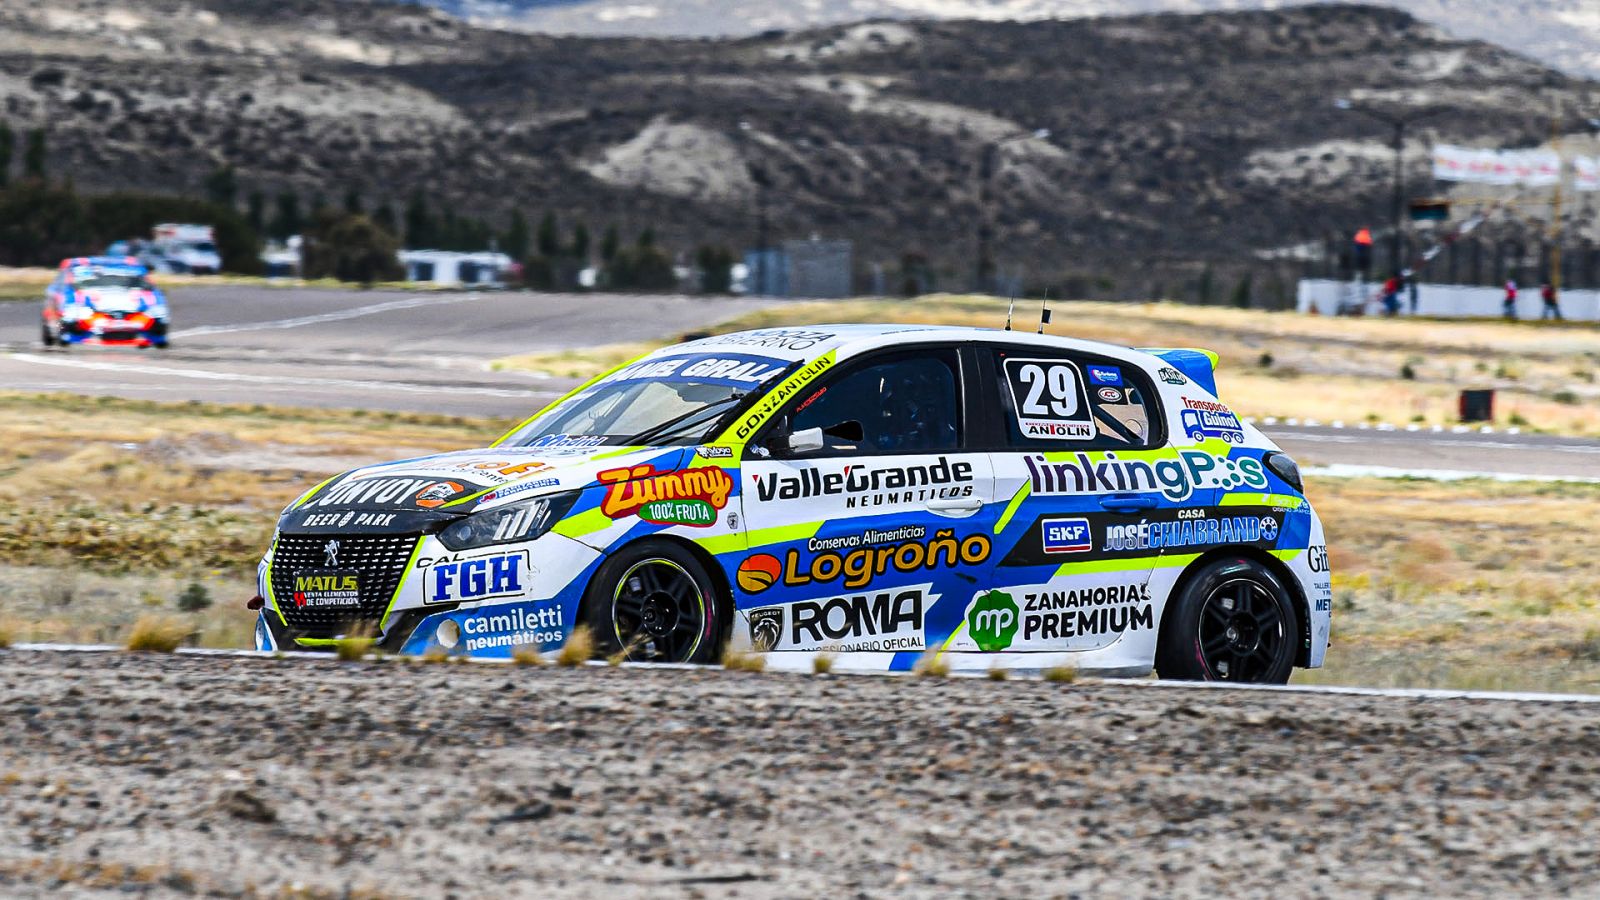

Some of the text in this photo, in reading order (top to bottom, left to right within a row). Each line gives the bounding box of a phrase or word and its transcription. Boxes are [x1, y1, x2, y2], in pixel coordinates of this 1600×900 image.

[1020, 364, 1078, 417] 29
[847, 486, 973, 508] NEUMATICOS
[303, 513, 397, 526] BEER PARK
[649, 502, 710, 520] 100% FRUTA
[1178, 509, 1205, 519] CASA
[808, 526, 925, 551] Conservas Alimenticias
[1048, 525, 1084, 541] SKF
[416, 553, 465, 568] CAL
[784, 530, 990, 587] Logroño
[295, 576, 359, 591] MATUS
[432, 555, 522, 601] FGH
[306, 598, 315, 606] DE
[464, 605, 562, 634] camiletti
[751, 610, 781, 619] PEUGEOT
[792, 590, 922, 644] ROMA
[1024, 604, 1154, 640] PREMIUM
[466, 630, 563, 651] neumáticos
[883, 637, 923, 650] OFICIAL
